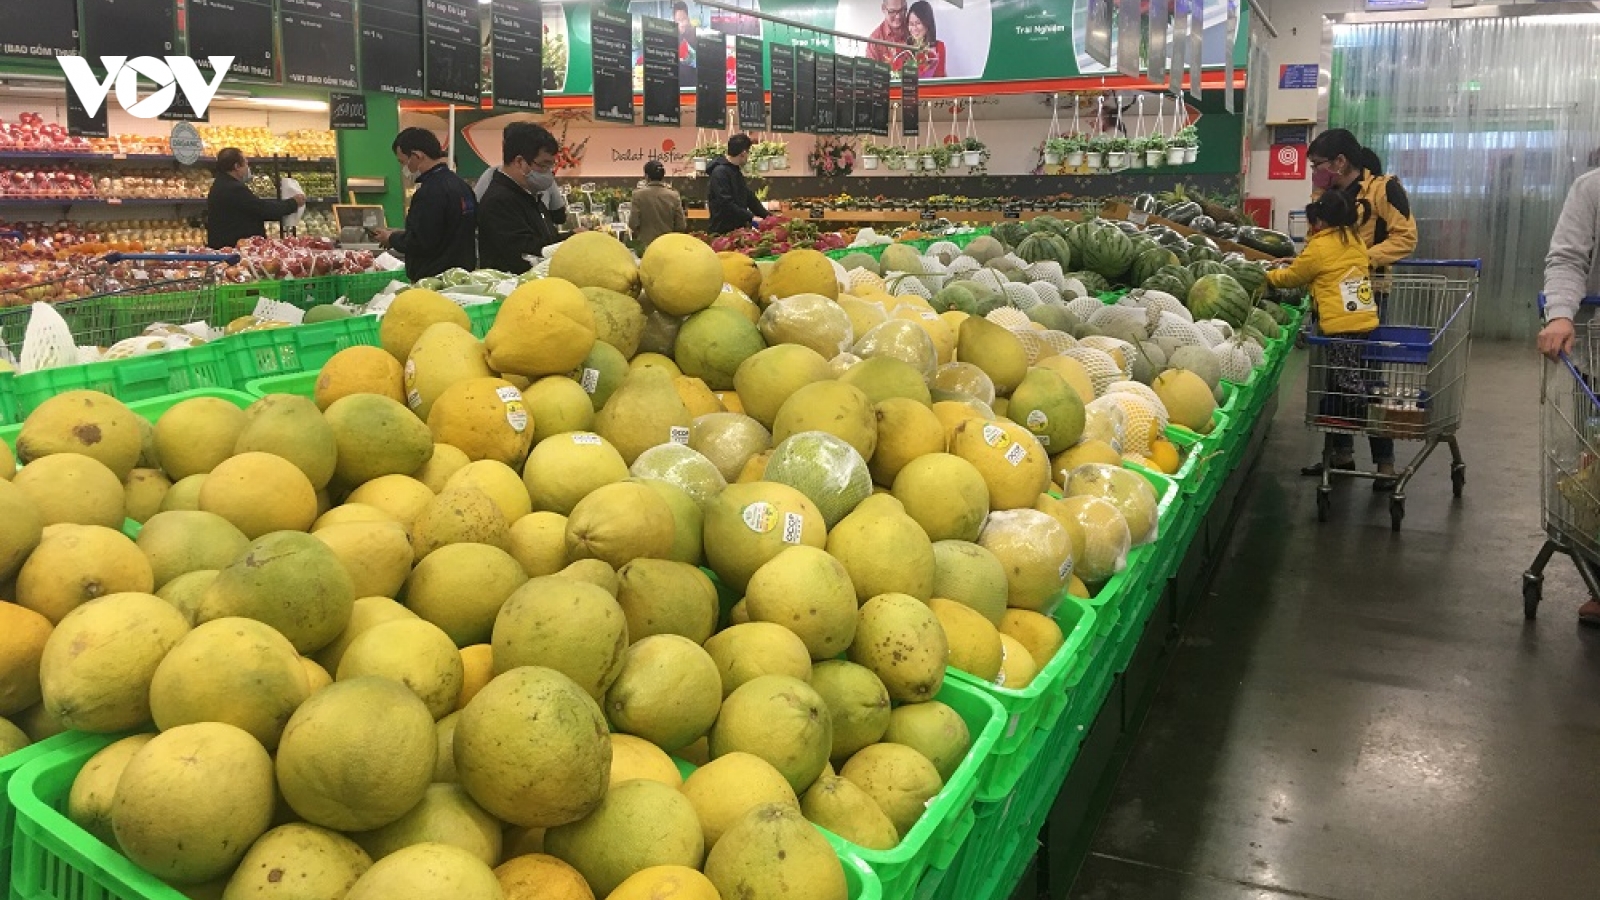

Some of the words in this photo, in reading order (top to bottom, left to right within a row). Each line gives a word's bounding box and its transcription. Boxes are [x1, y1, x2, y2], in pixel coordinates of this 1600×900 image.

[611, 147, 644, 162] Dalat
[647, 147, 690, 163] Hasfar
[785, 513, 796, 542] OCOP
